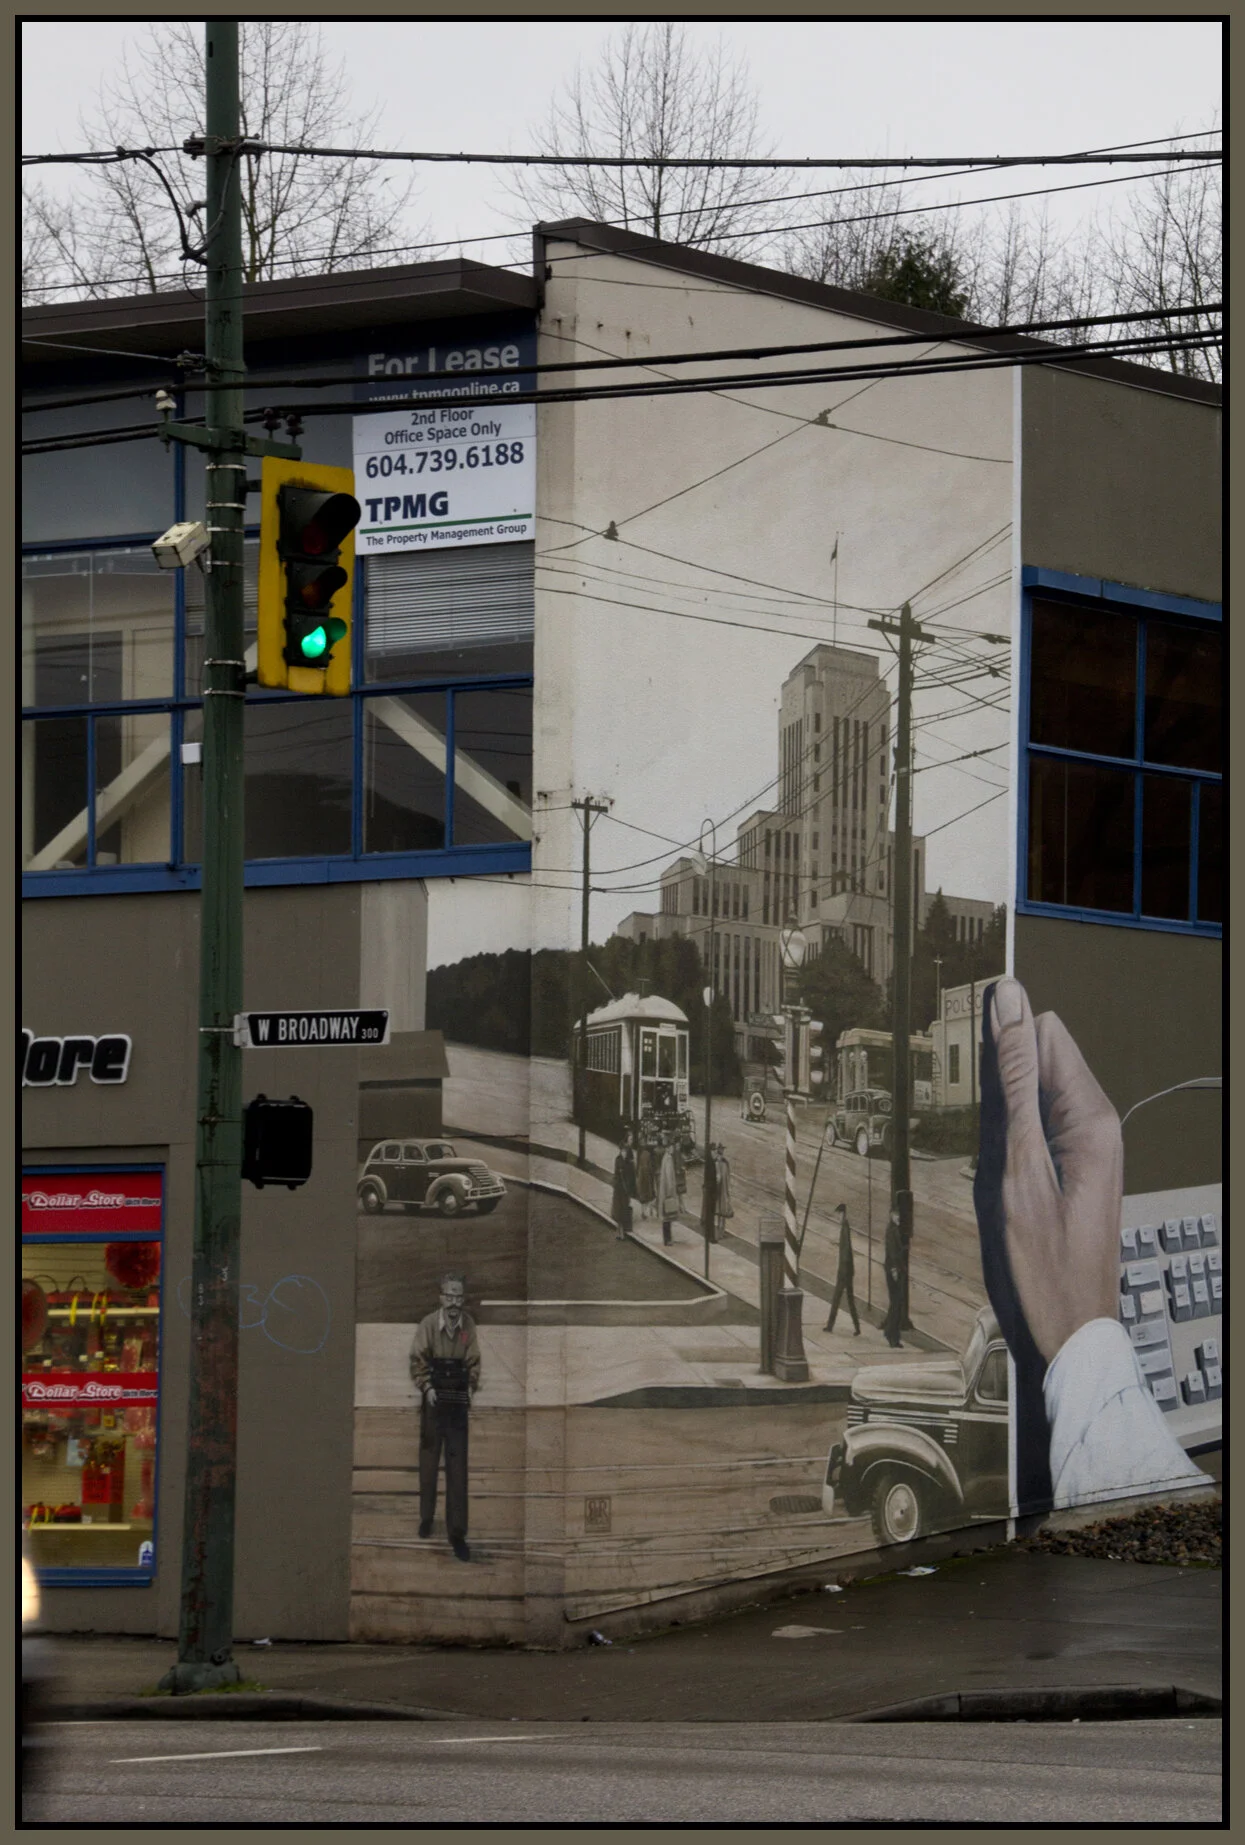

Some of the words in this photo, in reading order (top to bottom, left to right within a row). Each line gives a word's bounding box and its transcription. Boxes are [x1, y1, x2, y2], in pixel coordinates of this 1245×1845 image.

[368, 353, 419, 378] For
[429, 344, 520, 373] Lease
[411, 411, 436, 426] 2nd
[440, 408, 474, 422] Floor
[384, 430, 423, 445] Office
[427, 426, 467, 443] Space
[471, 421, 502, 437] Only
[365, 441, 525, 479] 604.739.6188
[365, 491, 449, 523] TPMG
[366, 535, 384, 547] The
[387, 532, 428, 545] Property
[431, 525, 494, 541] Management
[497, 523, 527, 535] Group
[258, 1018, 271, 1041] W
[278, 1016, 360, 1041] BROADWAY
[361, 1028, 379, 1039] 300
[30, 1192, 80, 1209] Dollar
[82, 1191, 124, 1208] Store
[28, 1383, 78, 1400] Dollar
[80, 1382, 121, 1399] Store
